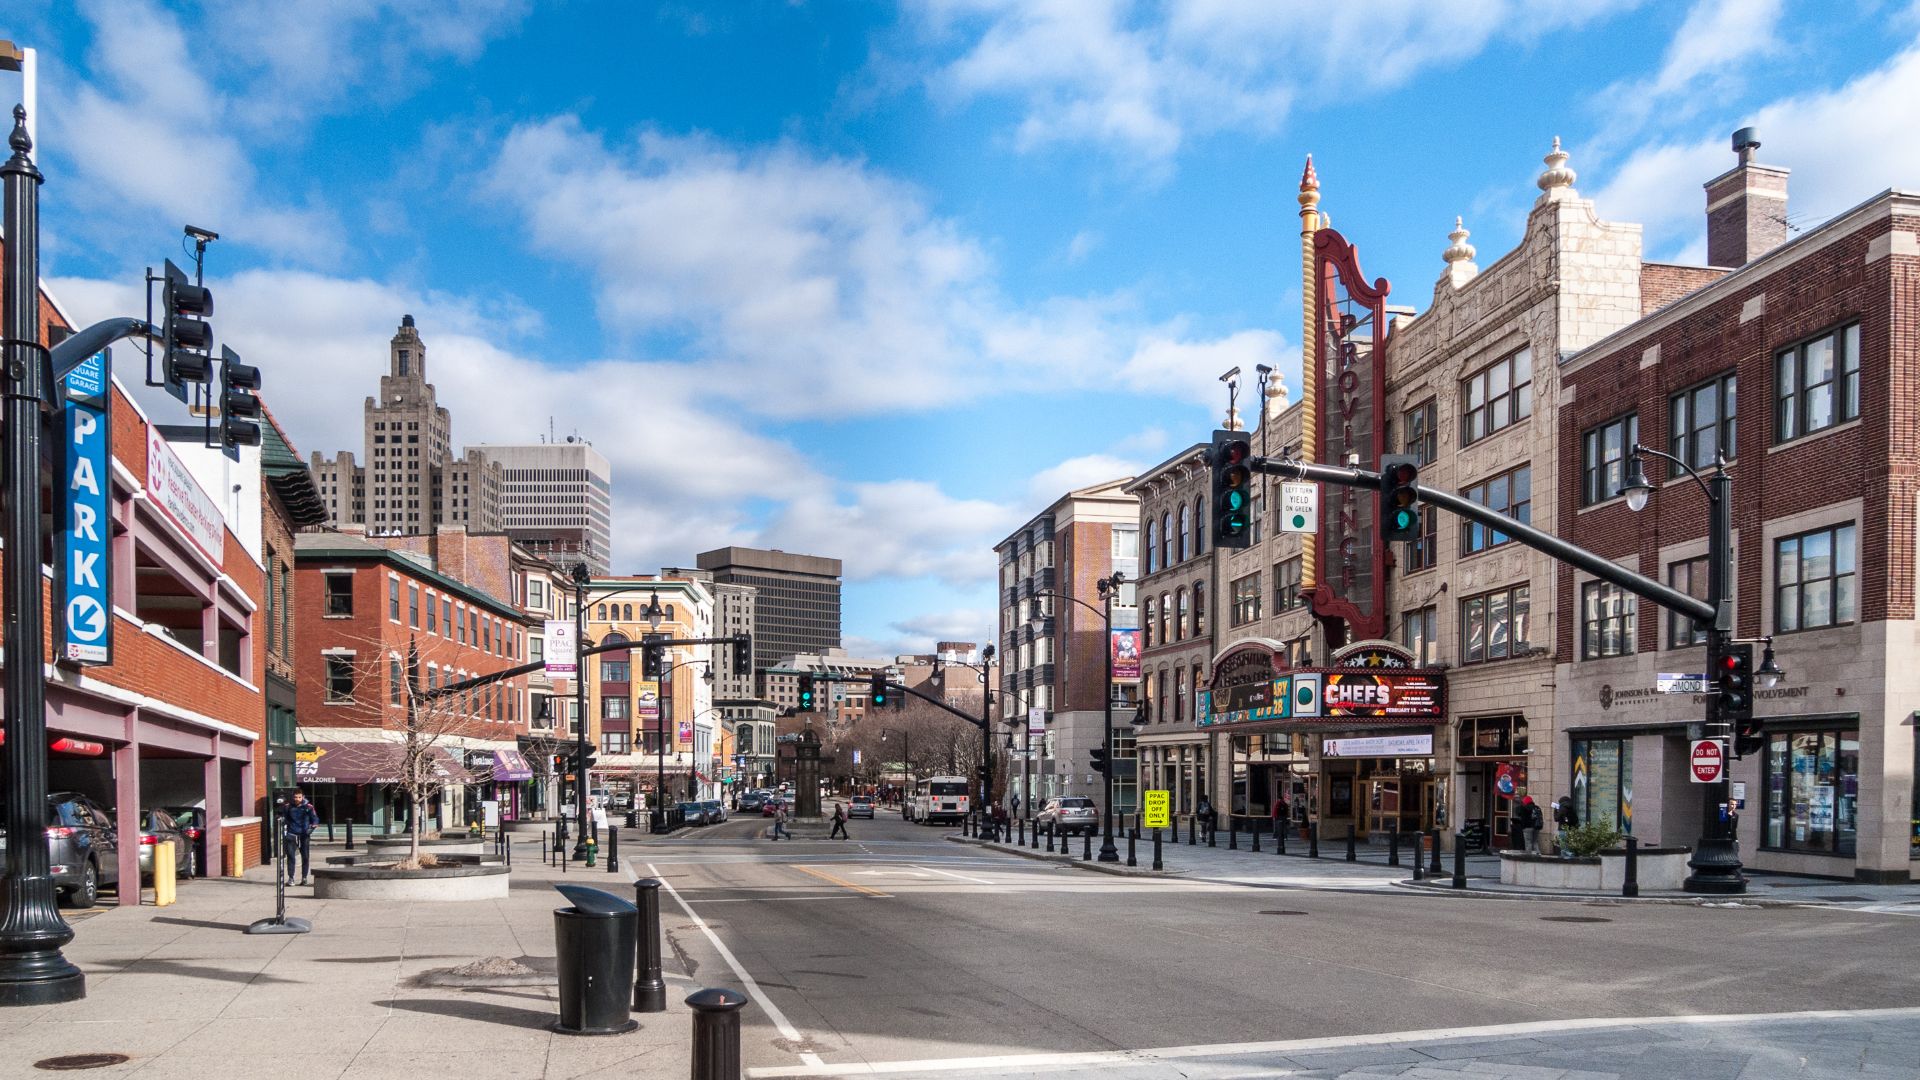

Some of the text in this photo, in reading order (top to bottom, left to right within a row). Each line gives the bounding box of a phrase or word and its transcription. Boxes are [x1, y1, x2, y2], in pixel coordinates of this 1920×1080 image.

[75, 367, 99, 379] QUARE
[70, 377, 99, 392] GARAGE
[70, 408, 100, 589] PARK
[1290, 496, 1309, 504] YIELD
[550, 640, 573, 648] PPAC
[1659, 680, 1701, 691] HMOND
[1325, 684, 1390, 705] CHEFS
[1615, 689, 1643, 698] JOHNSON
[1644, 688, 1650, 696] &
[1753, 686, 1809, 699] NVOLVEMENT
[1695, 748, 1717, 756] DO NOT
